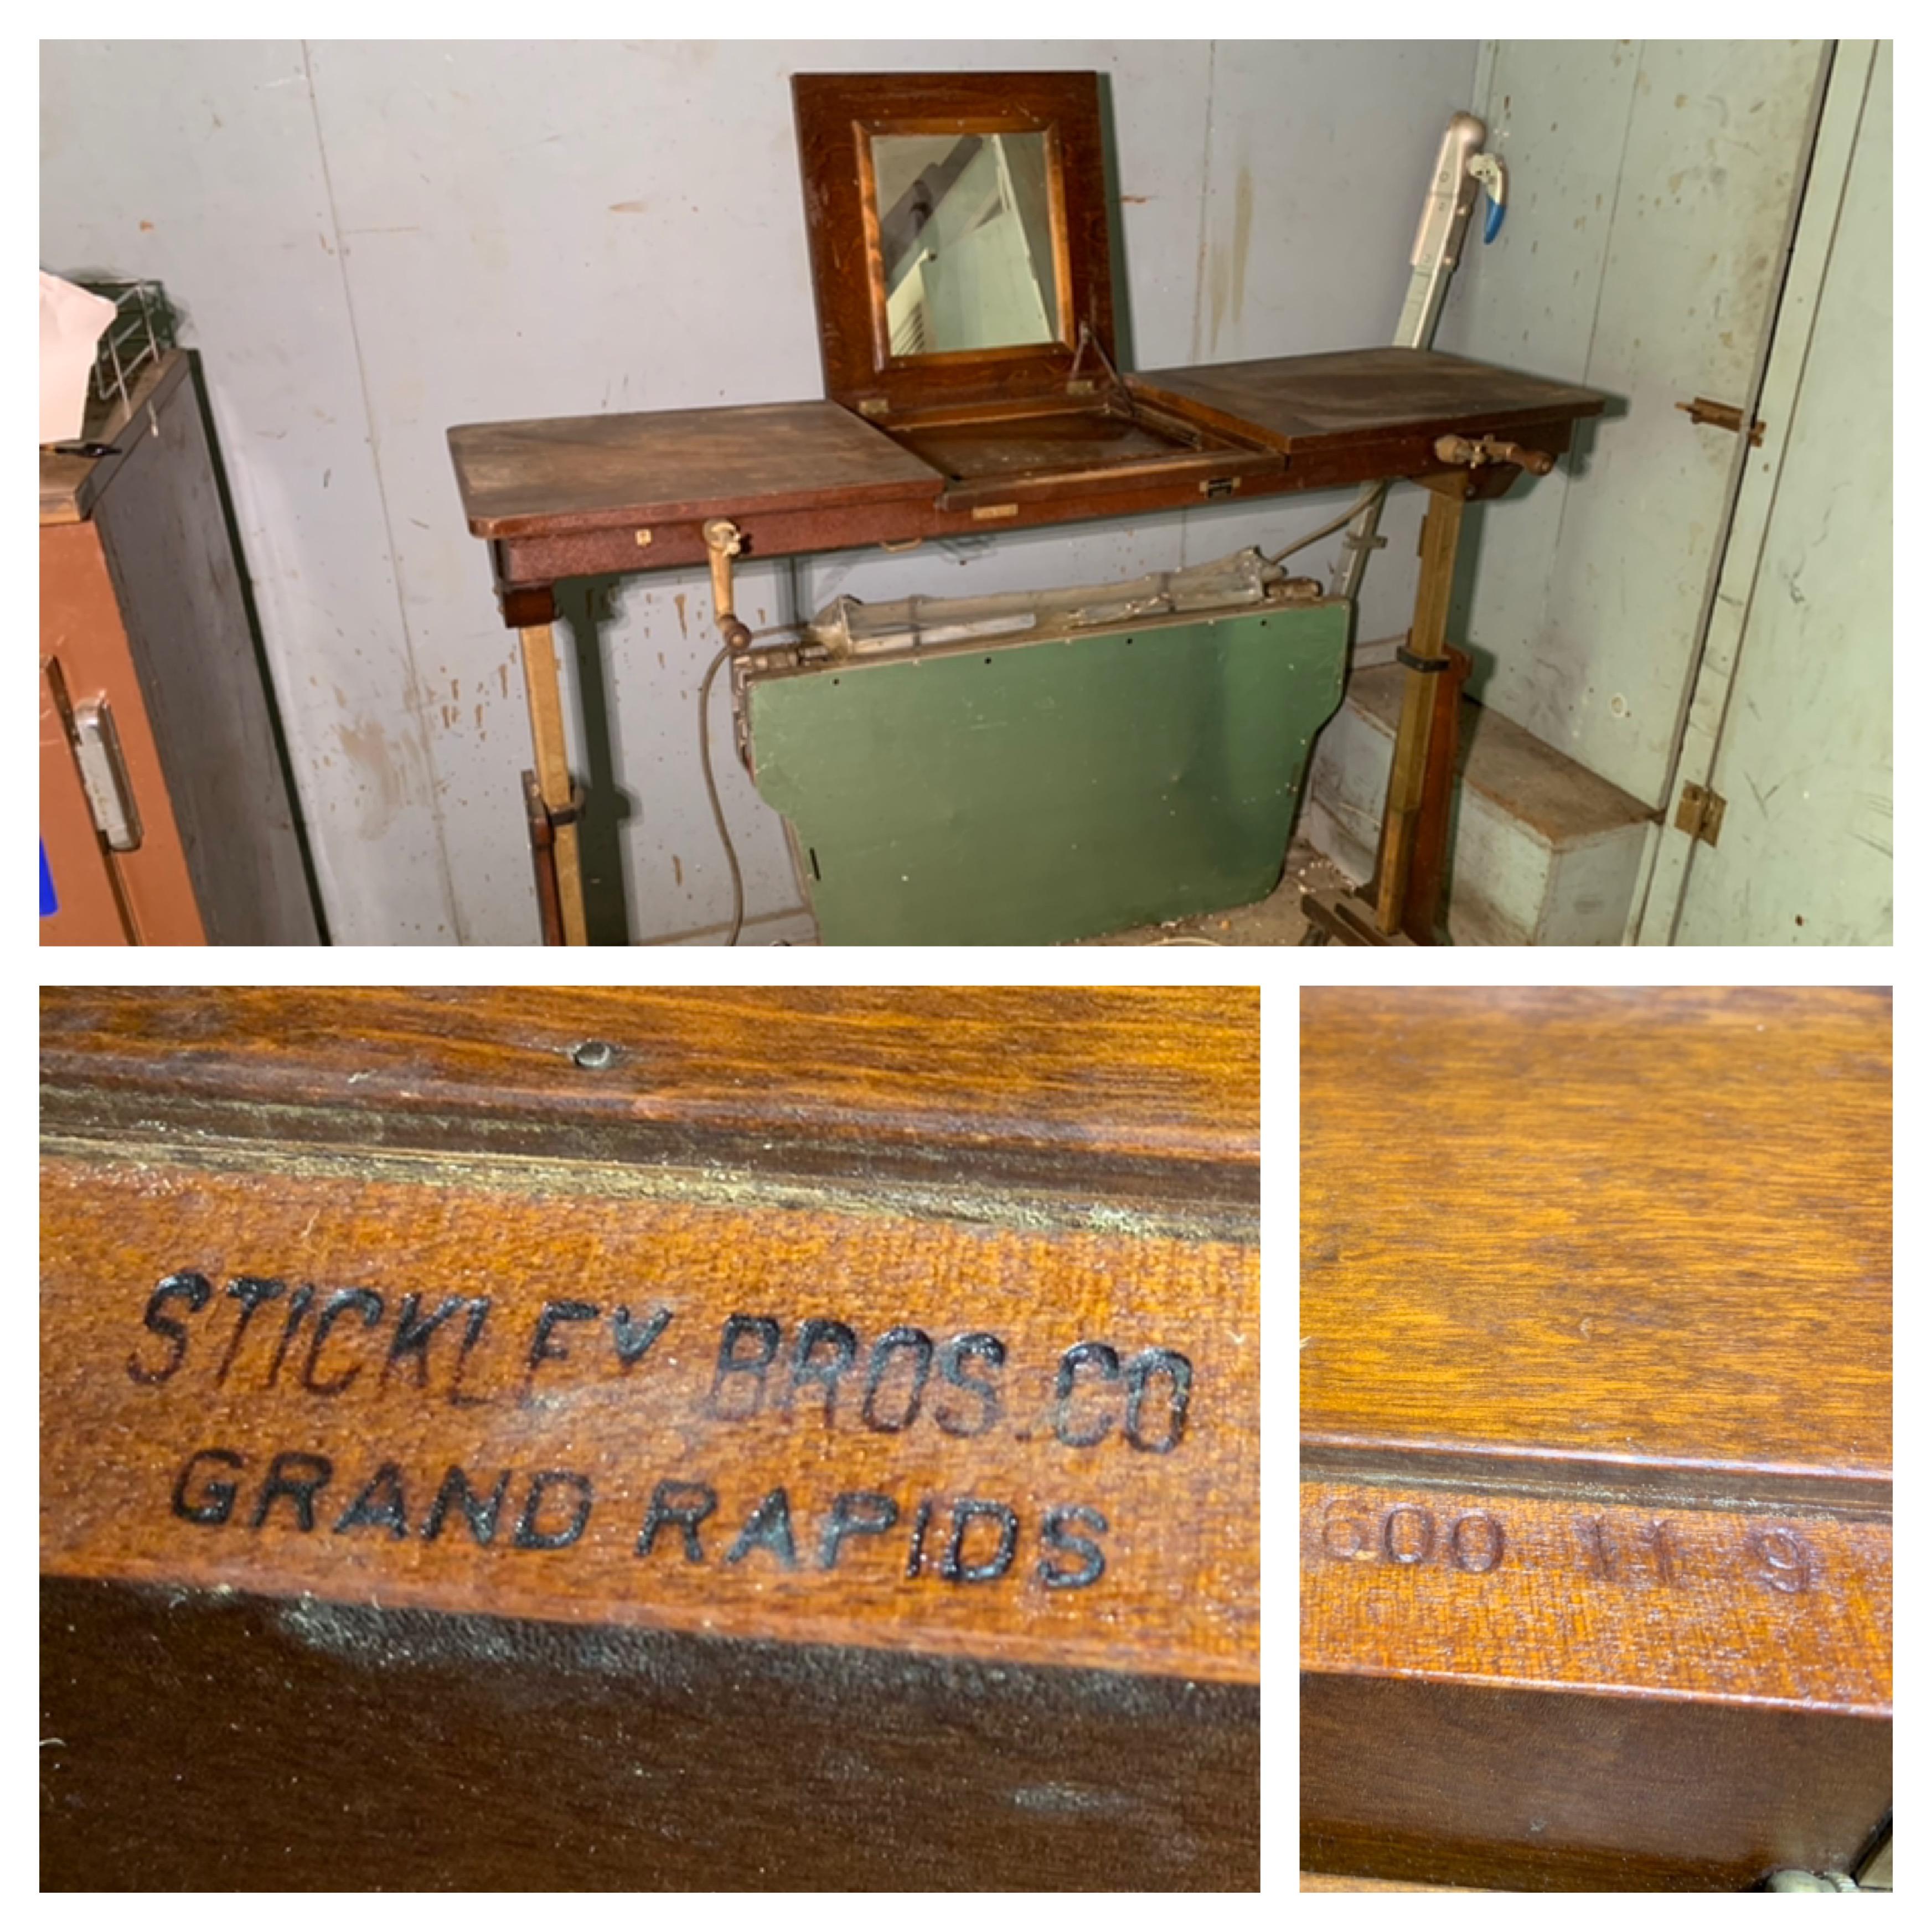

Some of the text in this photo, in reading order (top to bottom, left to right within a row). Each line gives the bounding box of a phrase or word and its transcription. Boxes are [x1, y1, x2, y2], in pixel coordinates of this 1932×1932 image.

[126, 1271, 674, 1409] STICKLEY
[171, 1448, 1109, 1590] GRAND RAPIDS
